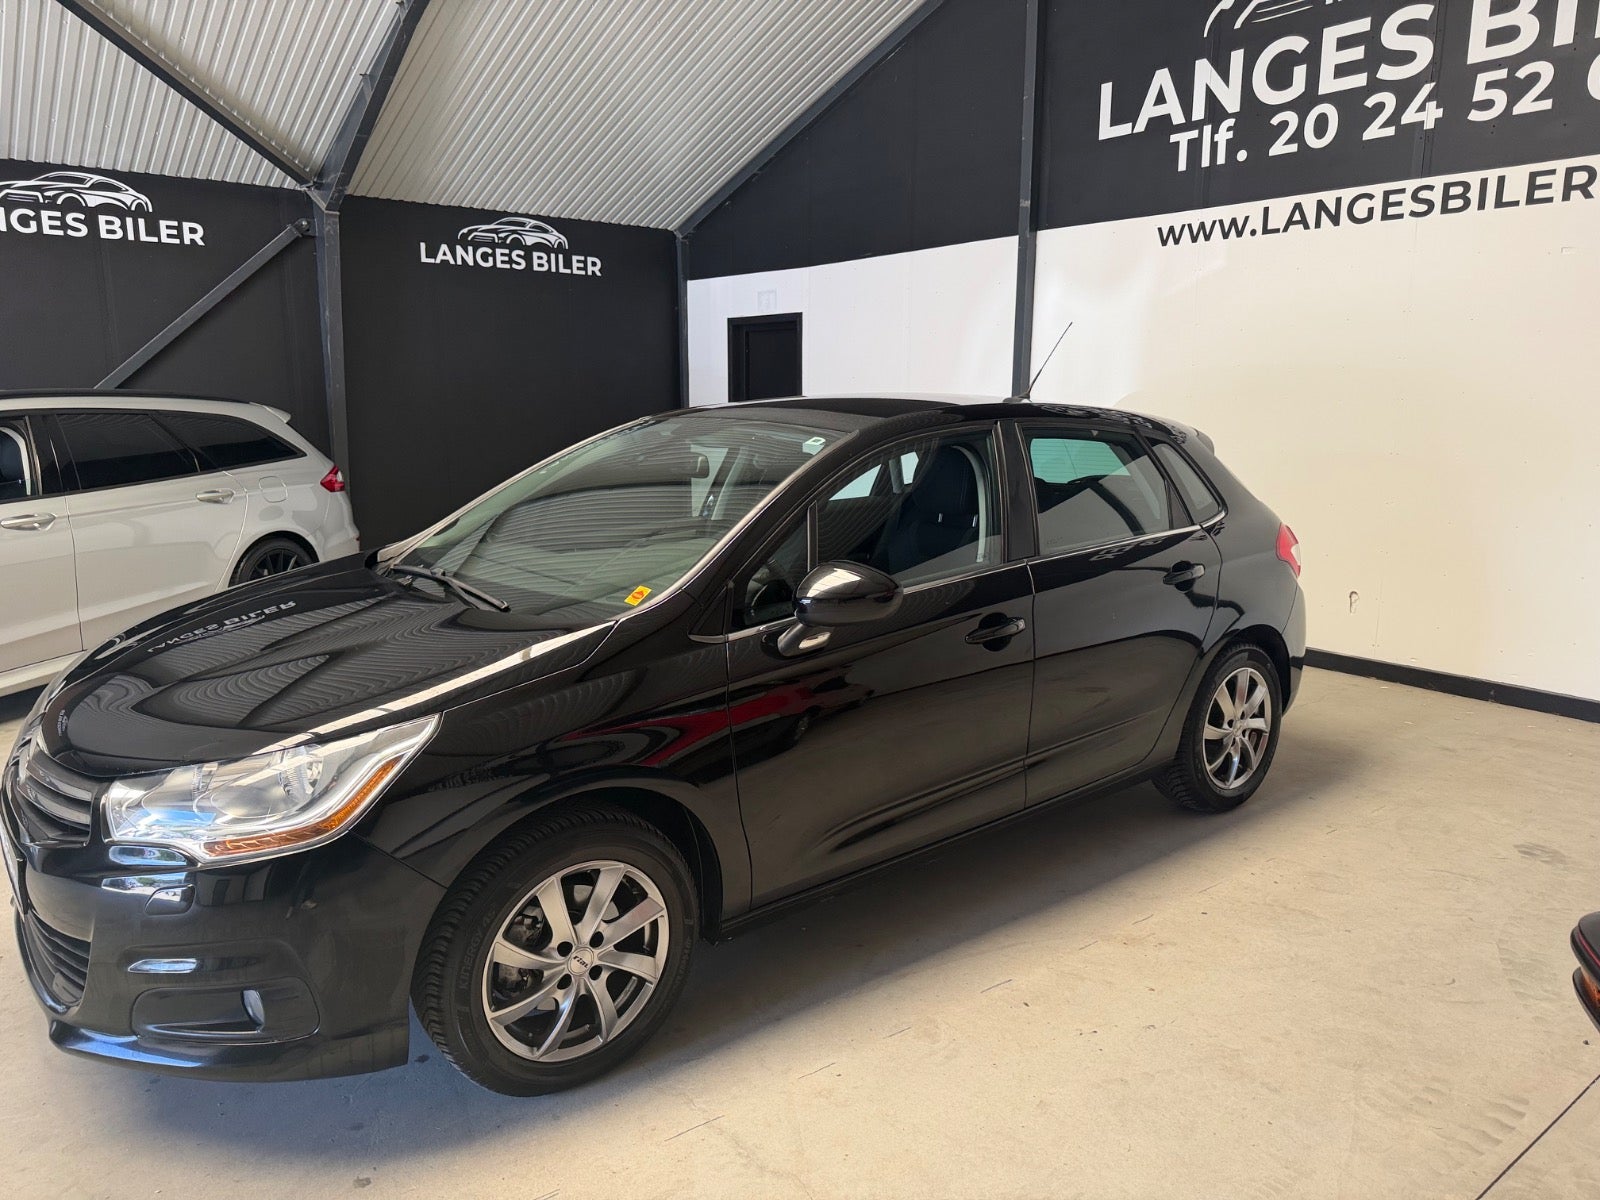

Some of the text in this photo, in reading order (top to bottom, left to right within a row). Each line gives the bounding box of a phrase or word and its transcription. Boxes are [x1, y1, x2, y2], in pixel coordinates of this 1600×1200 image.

[1098, 0, 1600, 141] LANGES BI
[1169, 117, 1248, 172] Tlf.
[1268, 102, 1339, 157] 20
[1362, 82, 1443, 141] 24
[1467, 60, 1554, 122] 52
[0, 206, 205, 247] GES BILER
[419, 241, 602, 277] LANGES BILER
